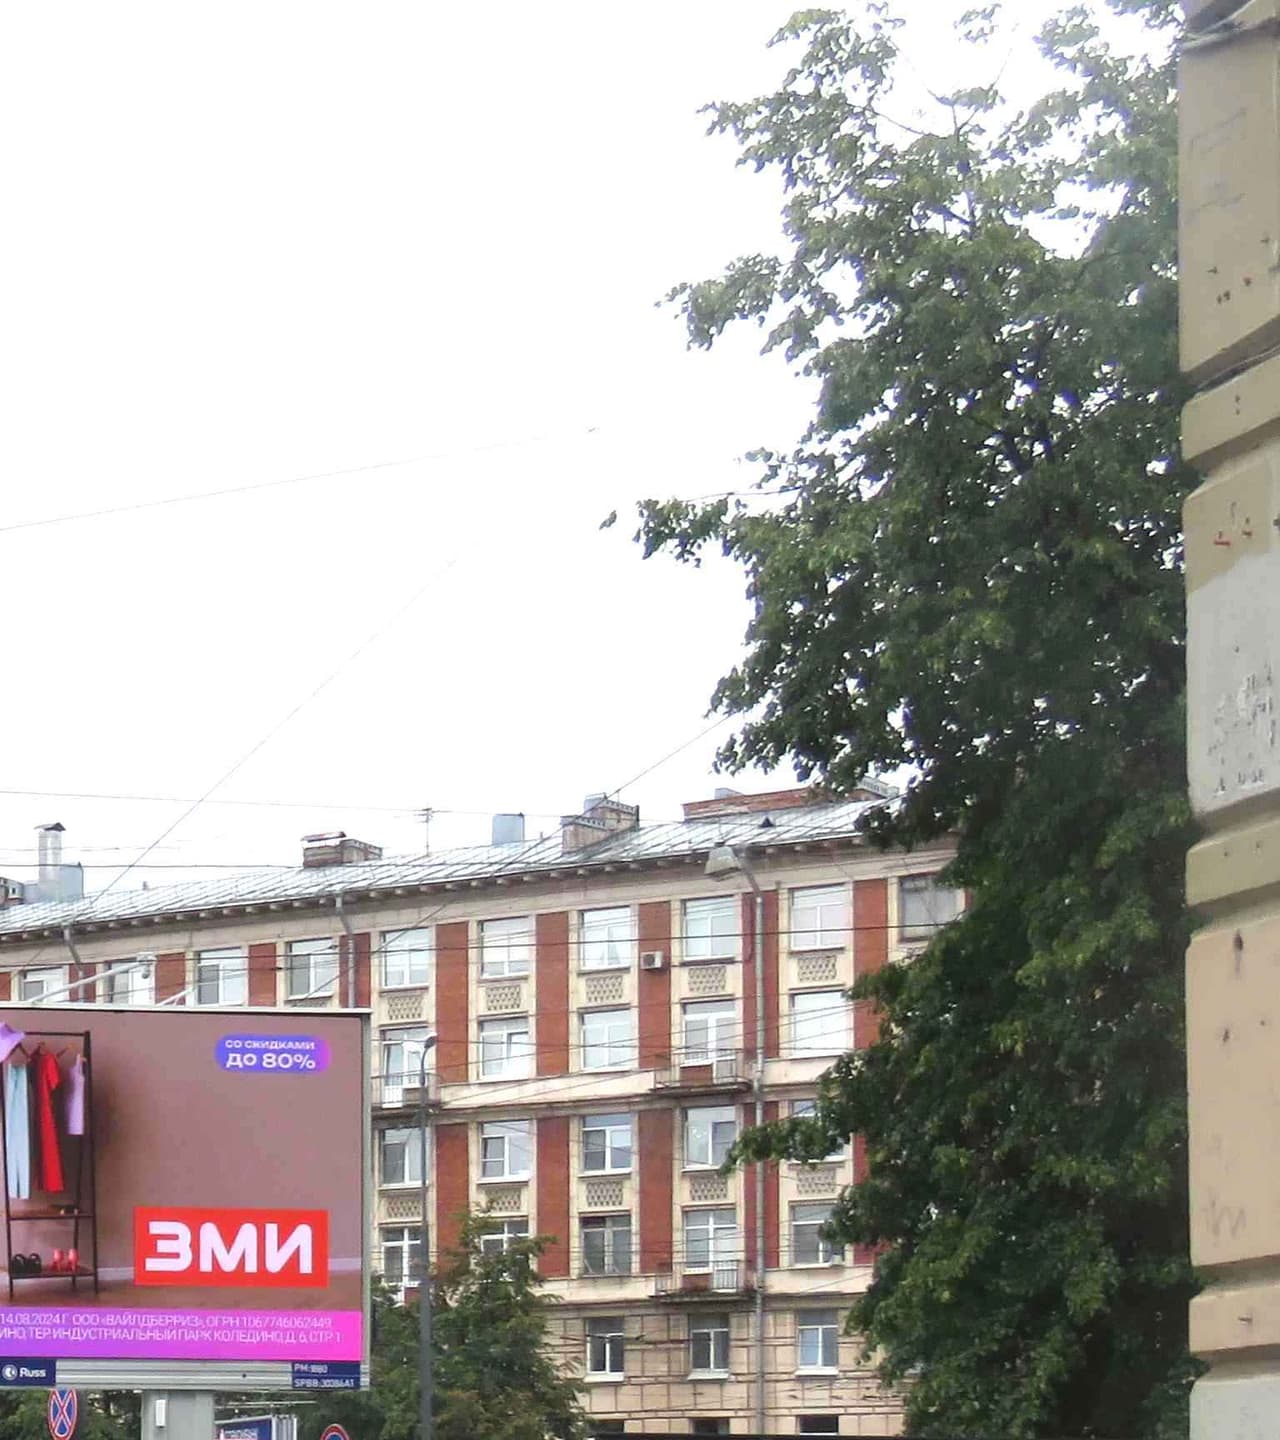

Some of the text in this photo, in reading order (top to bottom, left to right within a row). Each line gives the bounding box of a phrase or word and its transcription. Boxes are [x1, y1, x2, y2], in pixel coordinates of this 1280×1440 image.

[261, 1053, 316, 1070] 80%
[144, 1220, 313, 1274] ЗМИ
[72, 1314, 99, 1326] ООО
[206, 1315, 240, 1328] ОГРН
[52, 1328, 177, 1341] ИНДУСТРИАЛЬНЫЙ
[178, 1329, 213, 1341] ПАРК
[18, 1366, 47, 1378] Russ
